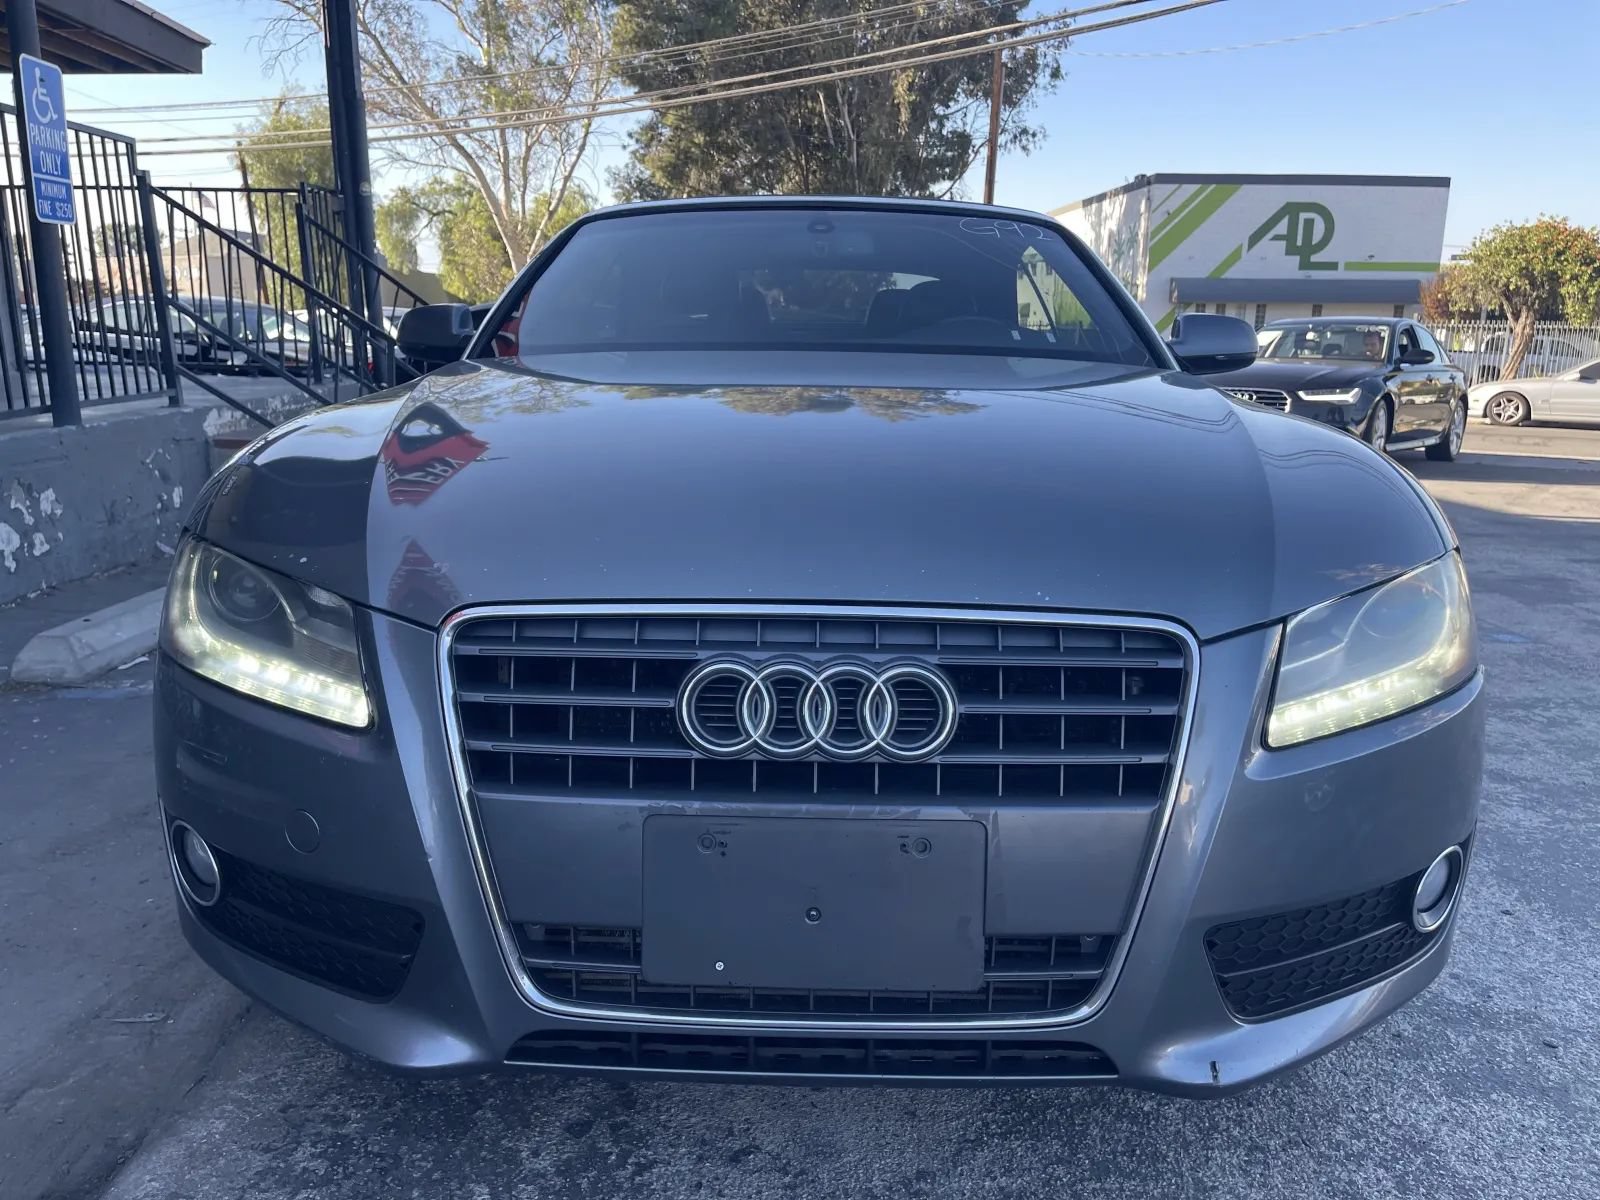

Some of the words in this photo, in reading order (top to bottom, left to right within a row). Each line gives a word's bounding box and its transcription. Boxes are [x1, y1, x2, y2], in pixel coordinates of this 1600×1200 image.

[30, 123, 67, 153] PARKING
[40, 151, 61, 175] ONLY
[40, 181, 67, 199] MINIMUM
[38, 200, 52, 216] FINE
[55, 202, 73, 218] $250
[1247, 201, 1339, 271] ADL
